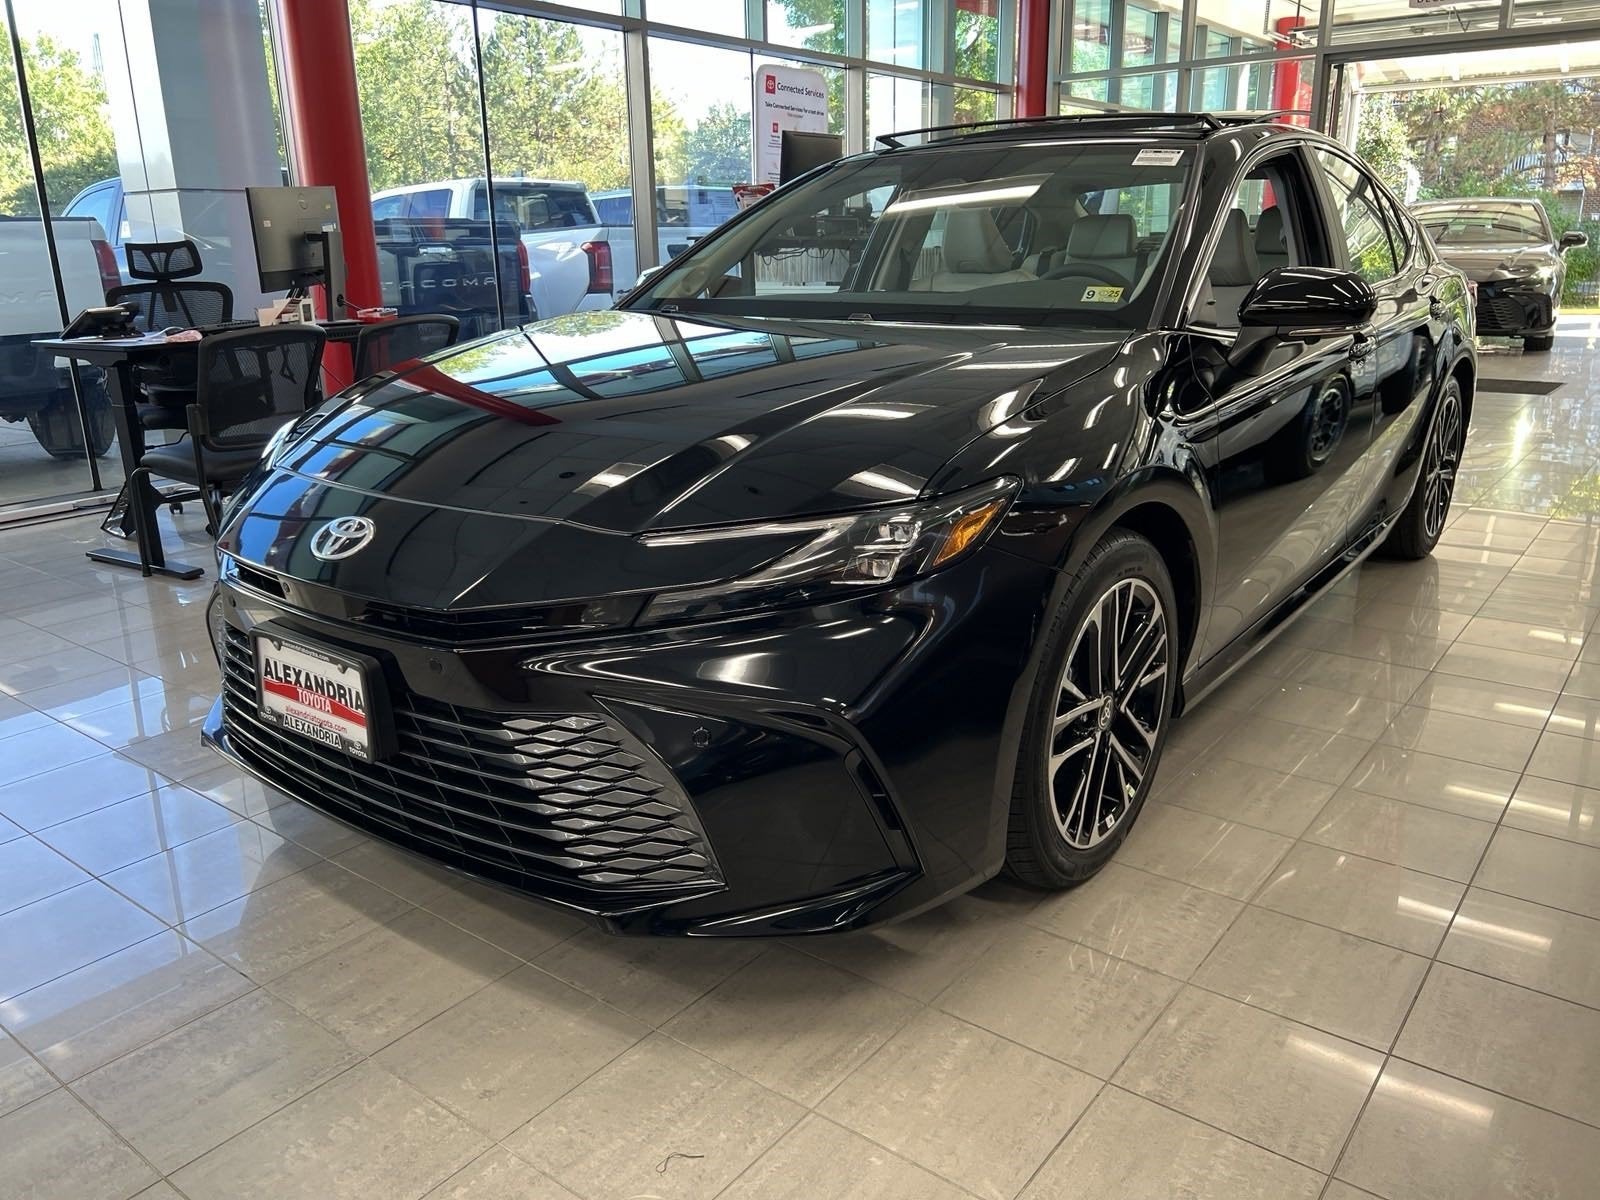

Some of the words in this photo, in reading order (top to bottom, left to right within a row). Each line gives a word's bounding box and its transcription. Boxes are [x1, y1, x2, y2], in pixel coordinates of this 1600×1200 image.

[777, 82, 804, 95] Connected
[805, 88, 825, 98] Services
[1086, 290, 1096, 299] 9
[1108, 290, 1120, 298] 25
[264, 658, 365, 713] ALEXANDRIA
[297, 688, 332, 714] TOYOTA
[261, 711, 277, 723] TOYOTA
[283, 714, 342, 749] ALEXANDRIA
[349, 747, 368, 759] TOYOTA
